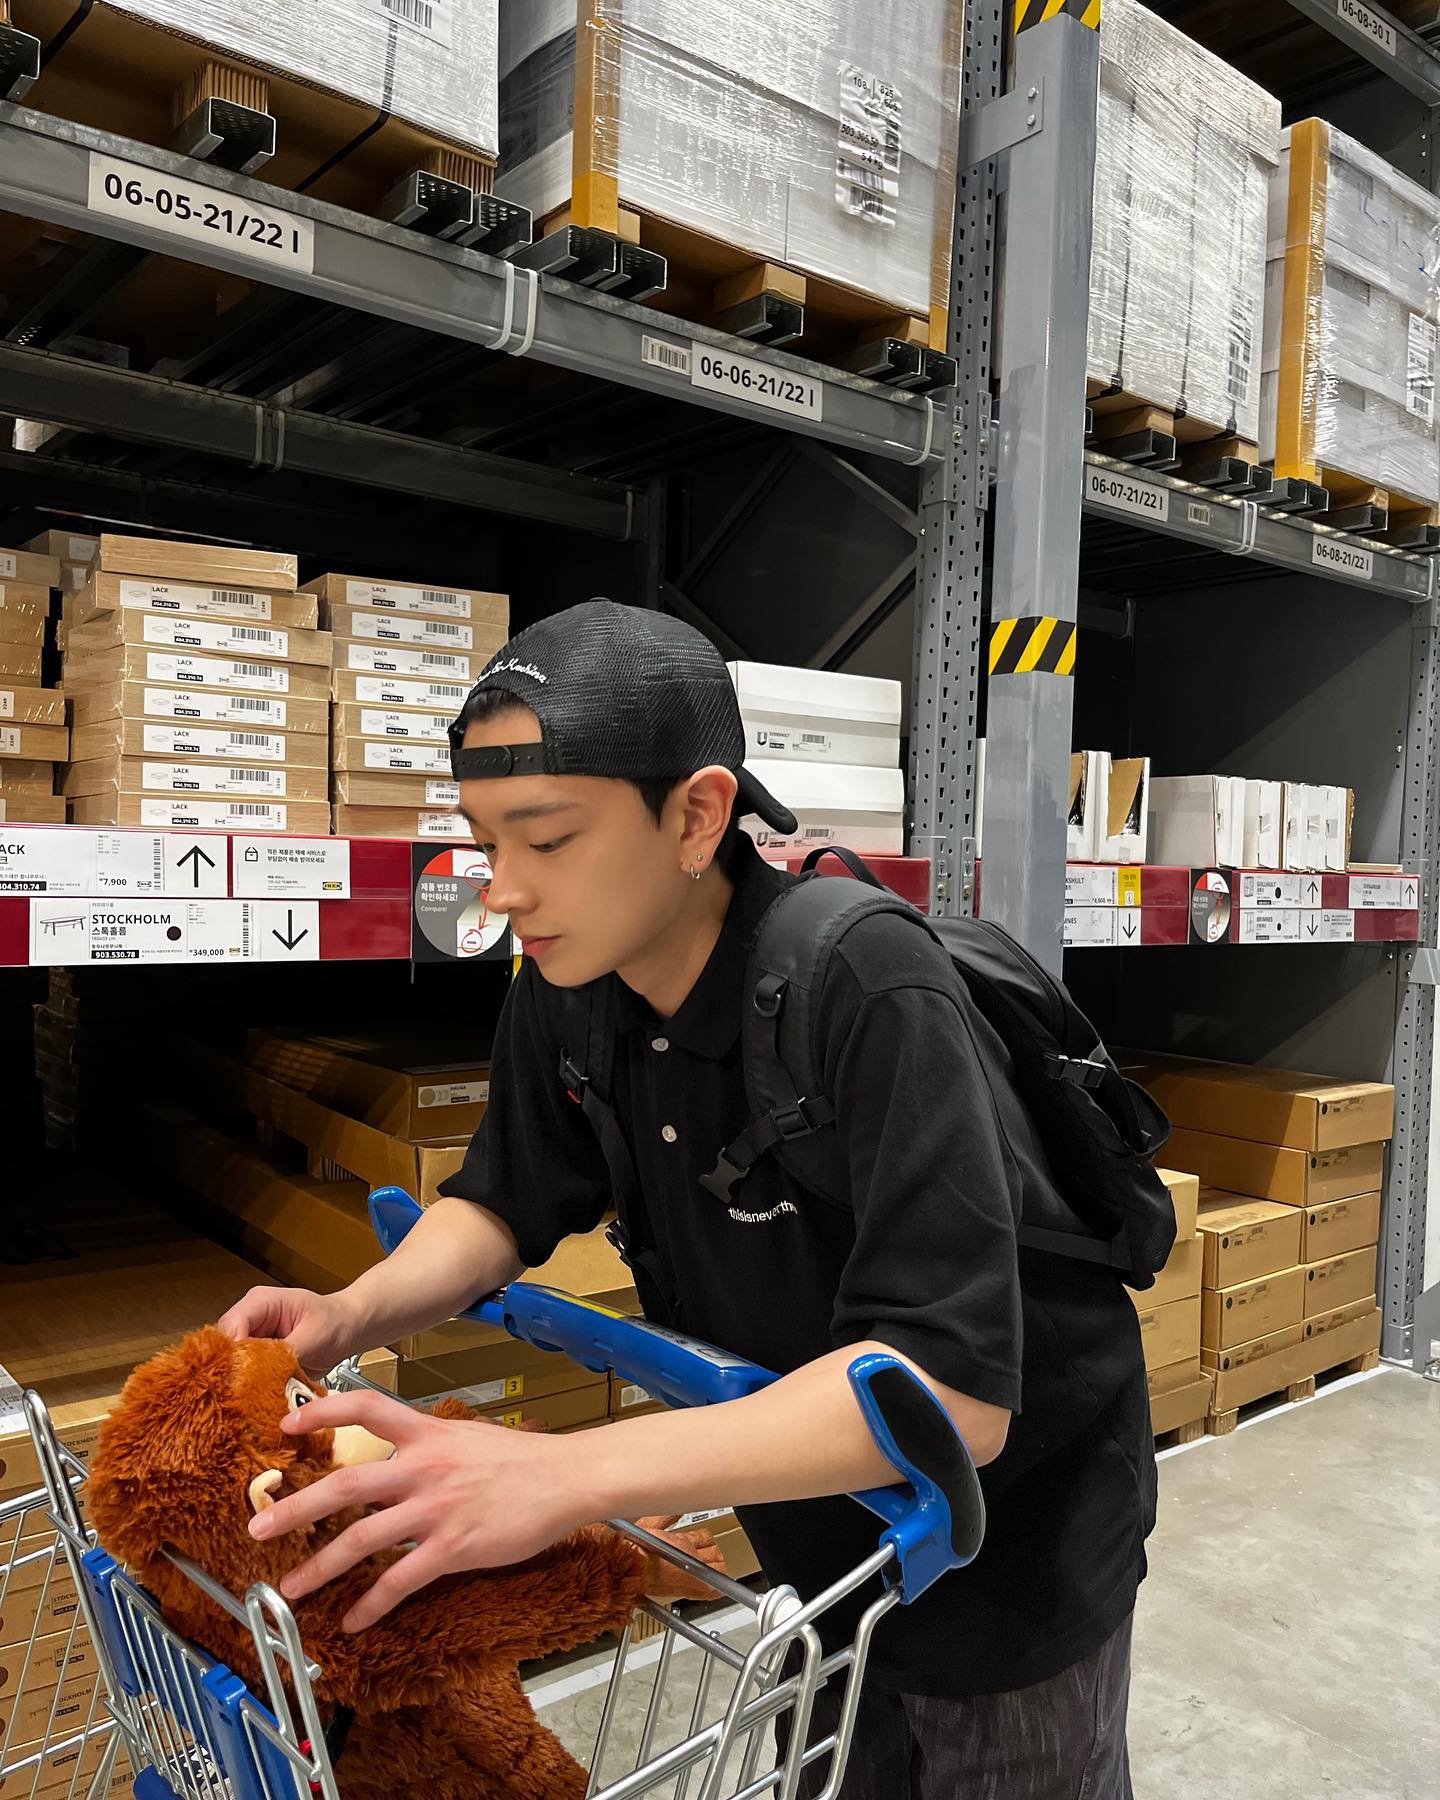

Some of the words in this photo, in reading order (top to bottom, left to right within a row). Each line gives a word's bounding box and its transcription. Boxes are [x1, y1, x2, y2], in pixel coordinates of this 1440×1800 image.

[1342, 0, 1384, 39] 06-08-30
[104, 173, 283, 249] 06-05-21/22
[700, 356, 805, 405] 06-06-21/22
[1091, 475, 1157, 508] 06-07-21/22
[1316, 542, 1365, 569] 06-08-21/22
[421, 882, 435, 892] 제품
[437, 882, 458, 892] 번호를
[421, 892, 458, 902] 확인하세요!
[92, 914, 171, 925] STOCKHOLM
[92, 926, 127, 936] 스톡홀름
[95, 951, 136, 959] 903.530.78
[510, 1381, 517, 1392] 3
